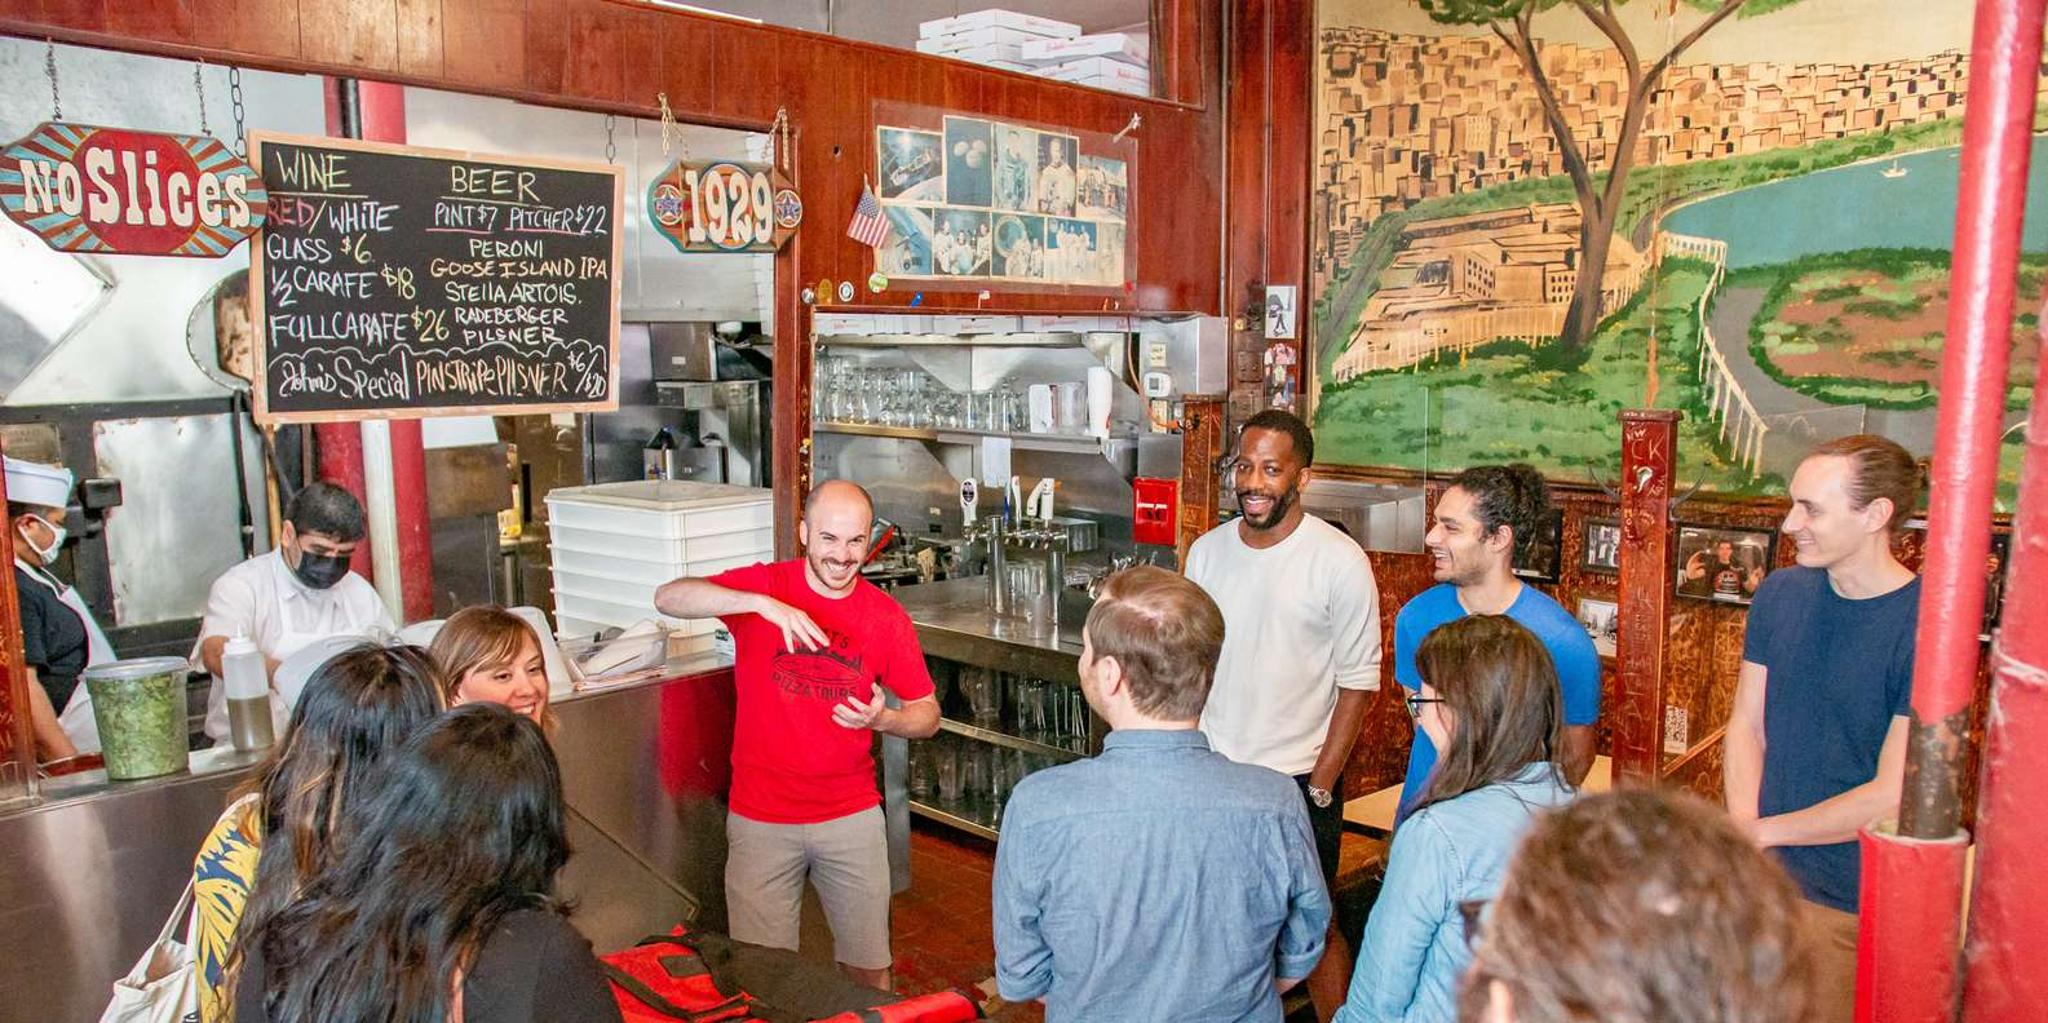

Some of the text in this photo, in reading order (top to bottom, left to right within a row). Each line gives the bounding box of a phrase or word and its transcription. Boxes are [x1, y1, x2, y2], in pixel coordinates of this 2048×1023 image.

[276, 148, 352, 191] WINE
[452, 166, 541, 202] BEER
[685, 170, 773, 244] 1929
[267, 233, 332, 264] GLASS
[469, 239, 543, 259] PERONI
[293, 266, 378, 299] CARAFE
[381, 263, 416, 300] $18
[430, 256, 608, 280] GOOSE ISLAND IPA
[411, 305, 450, 342] $26
[454, 305, 569, 325] RADEBERGER
[463, 327, 564, 346] PILSNER
[771, 671, 811, 696] PIZZA
